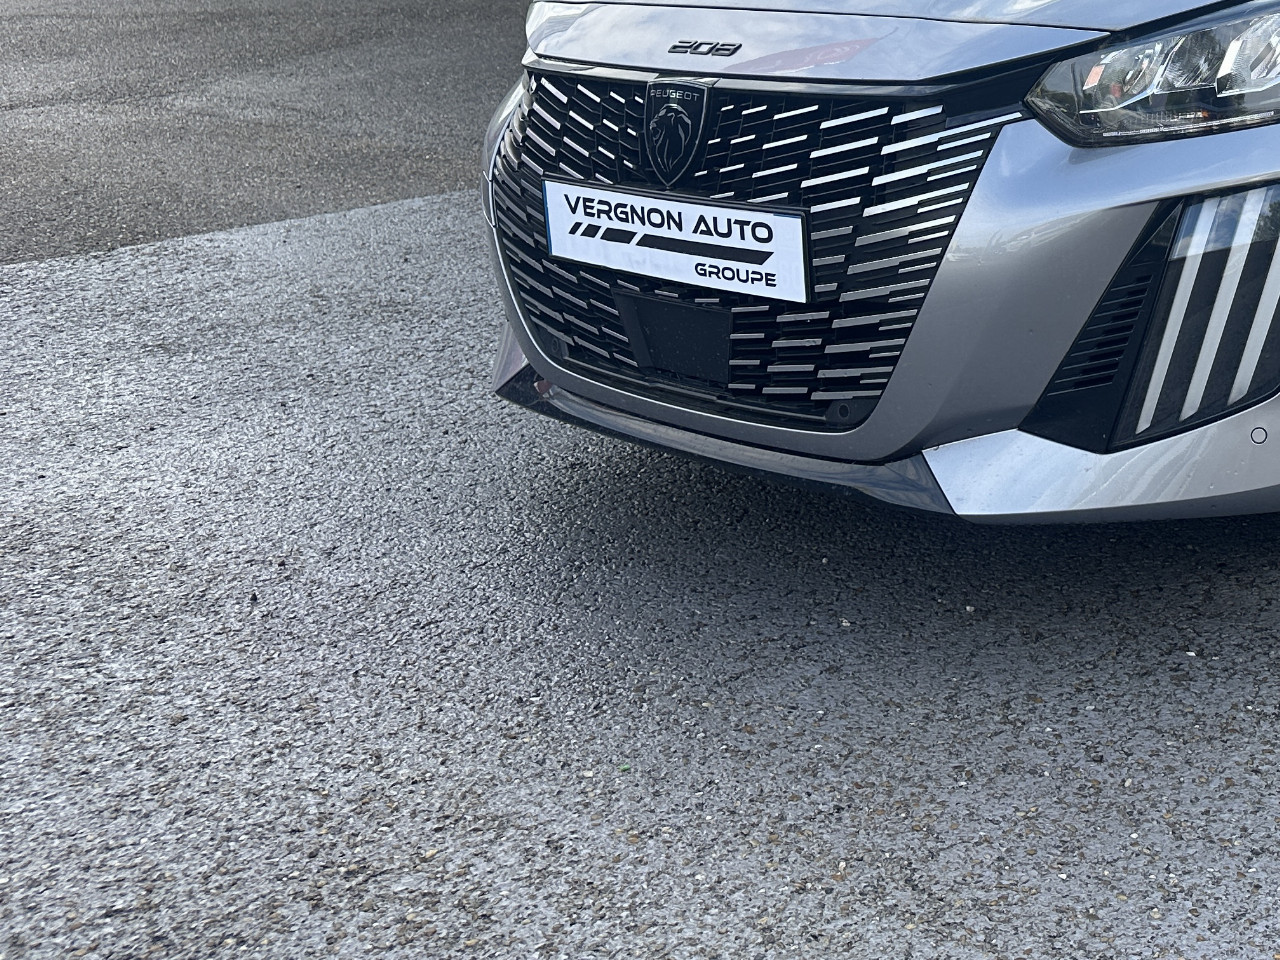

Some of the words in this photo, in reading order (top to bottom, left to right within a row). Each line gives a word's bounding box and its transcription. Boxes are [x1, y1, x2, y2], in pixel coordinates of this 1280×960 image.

[668, 39, 742, 57] 208
[650, 89, 700, 101] PEUGEOT
[563, 193, 683, 232] VERGNON
[692, 214, 774, 244] AUTO
[694, 262, 777, 288] GROUPE
